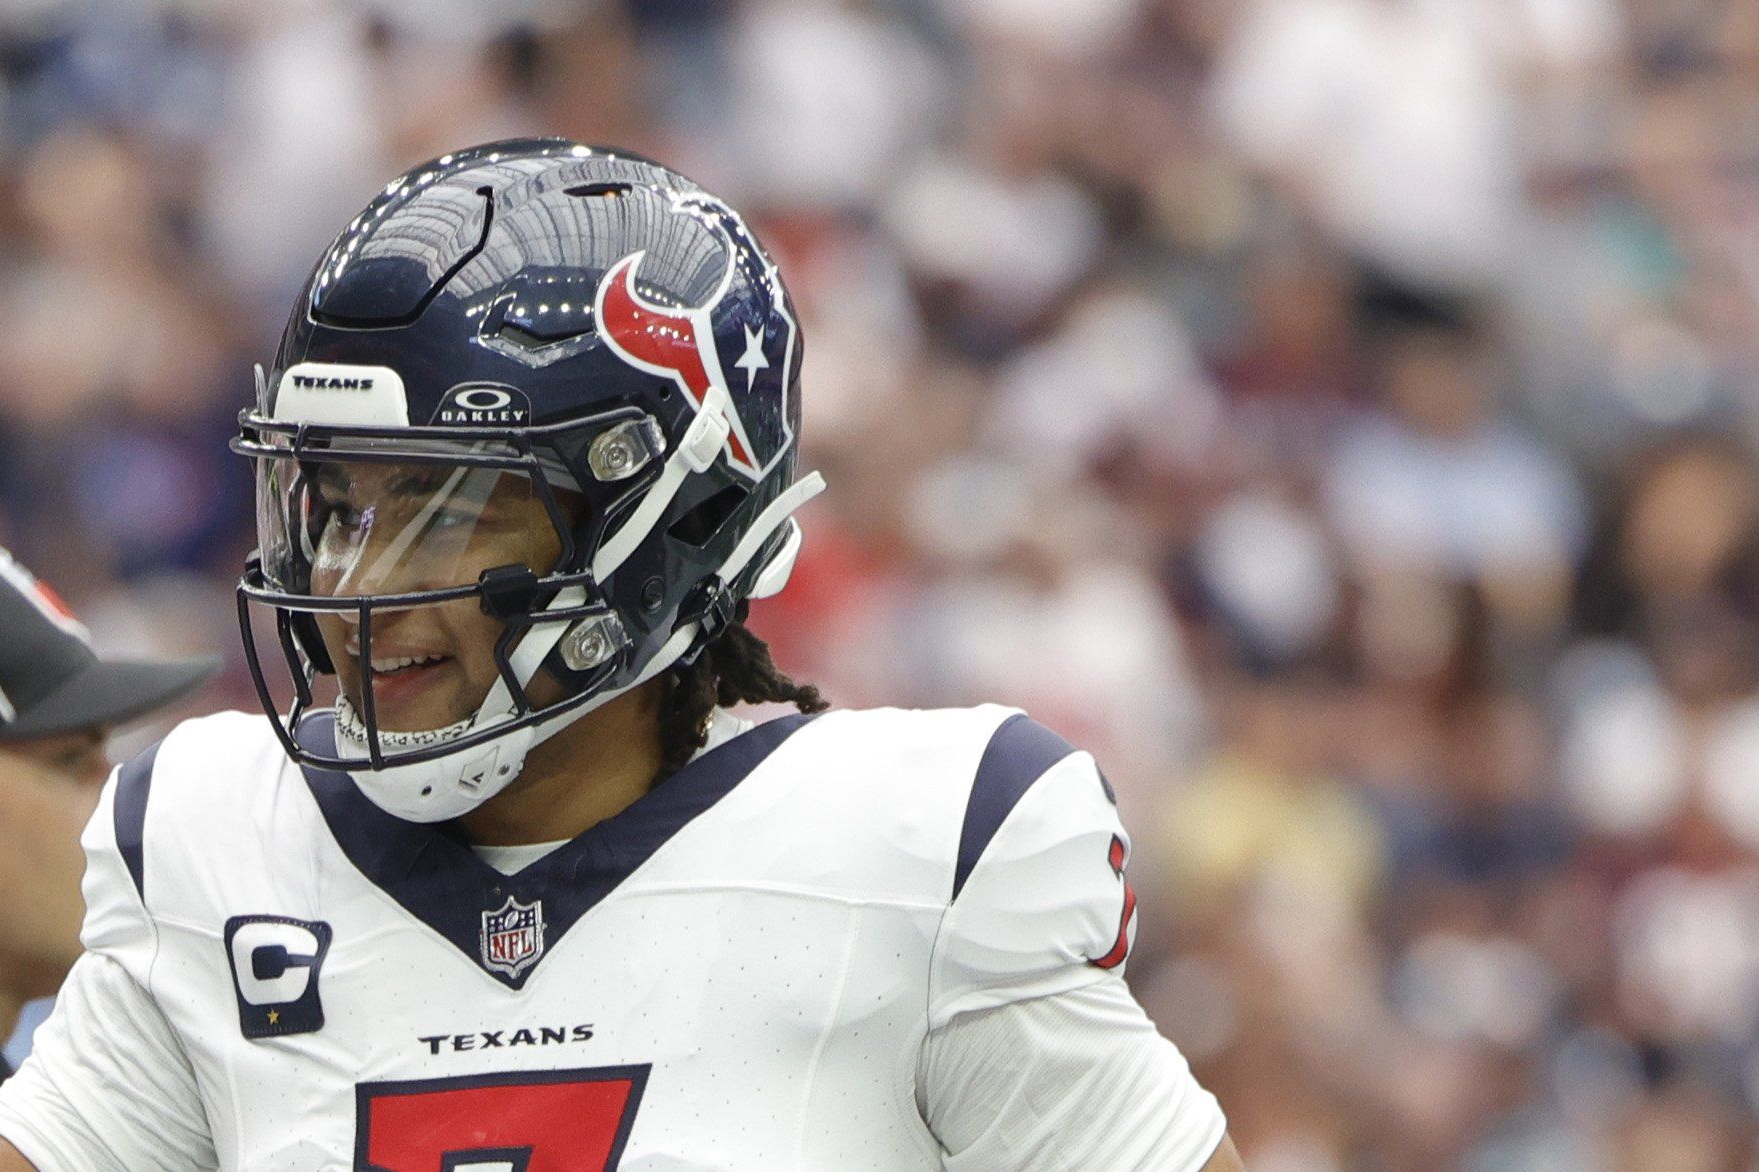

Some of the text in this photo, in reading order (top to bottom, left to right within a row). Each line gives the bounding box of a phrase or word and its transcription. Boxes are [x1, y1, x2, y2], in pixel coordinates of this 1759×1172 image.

[292, 375, 374, 390] TEXANS
[441, 410, 524, 422] OAKLEY
[492, 930, 533, 960] NFL
[230, 923, 319, 1005] C
[418, 1023, 595, 1054] TEXANS
